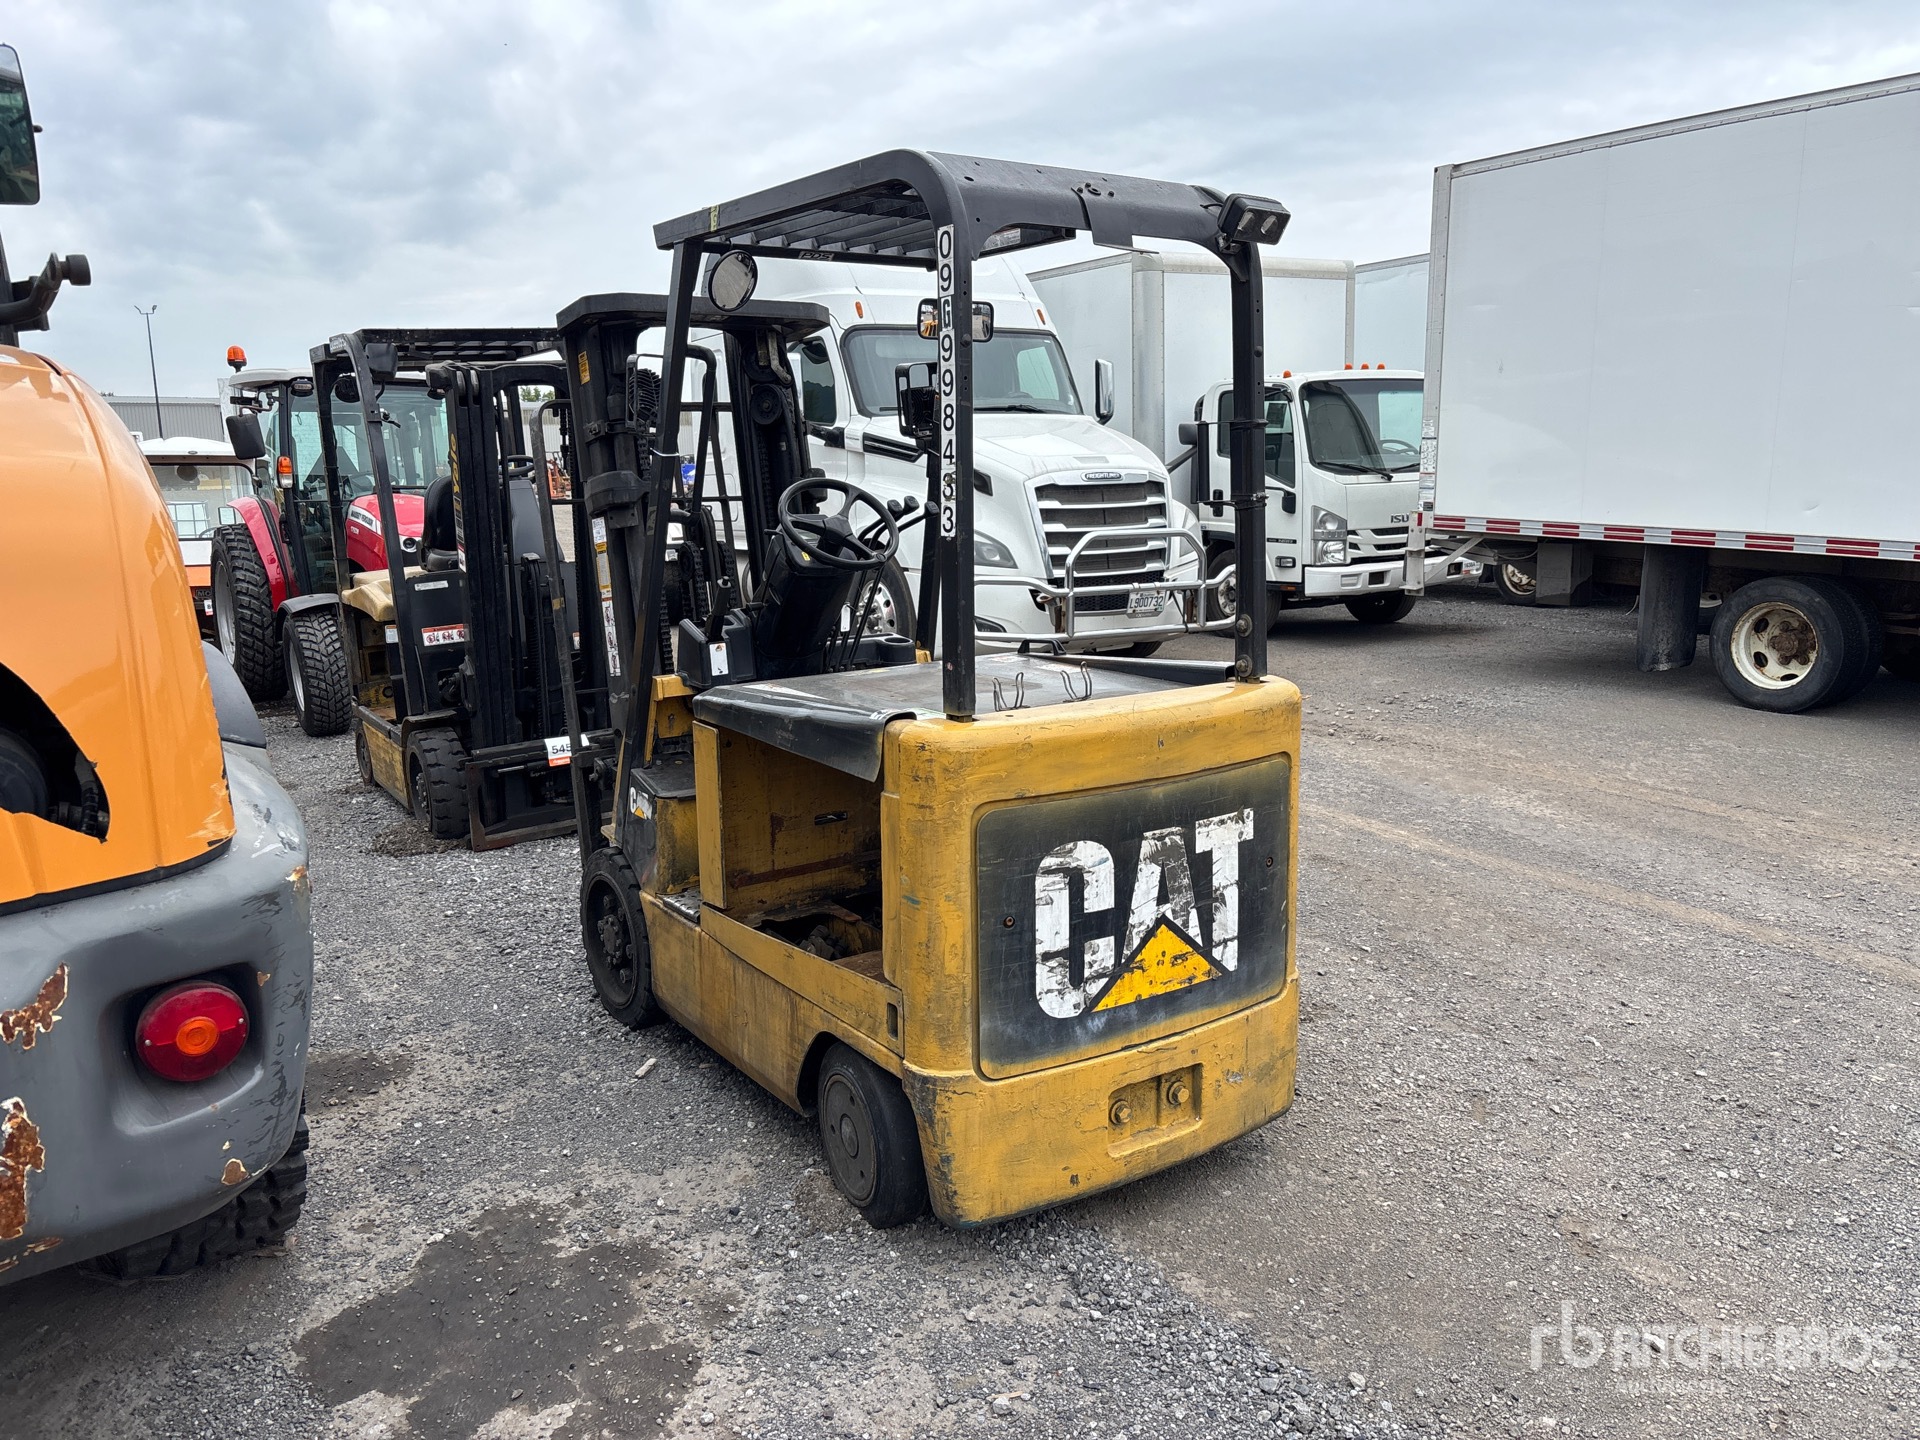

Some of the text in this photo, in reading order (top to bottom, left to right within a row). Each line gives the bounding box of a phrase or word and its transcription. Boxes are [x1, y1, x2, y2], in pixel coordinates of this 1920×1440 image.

[801, 252, 831, 260] PDS
[450, 433, 460, 493] Yale
[1130, 596, 1164, 609] L900732
[1035, 808, 1254, 1018] CAT
